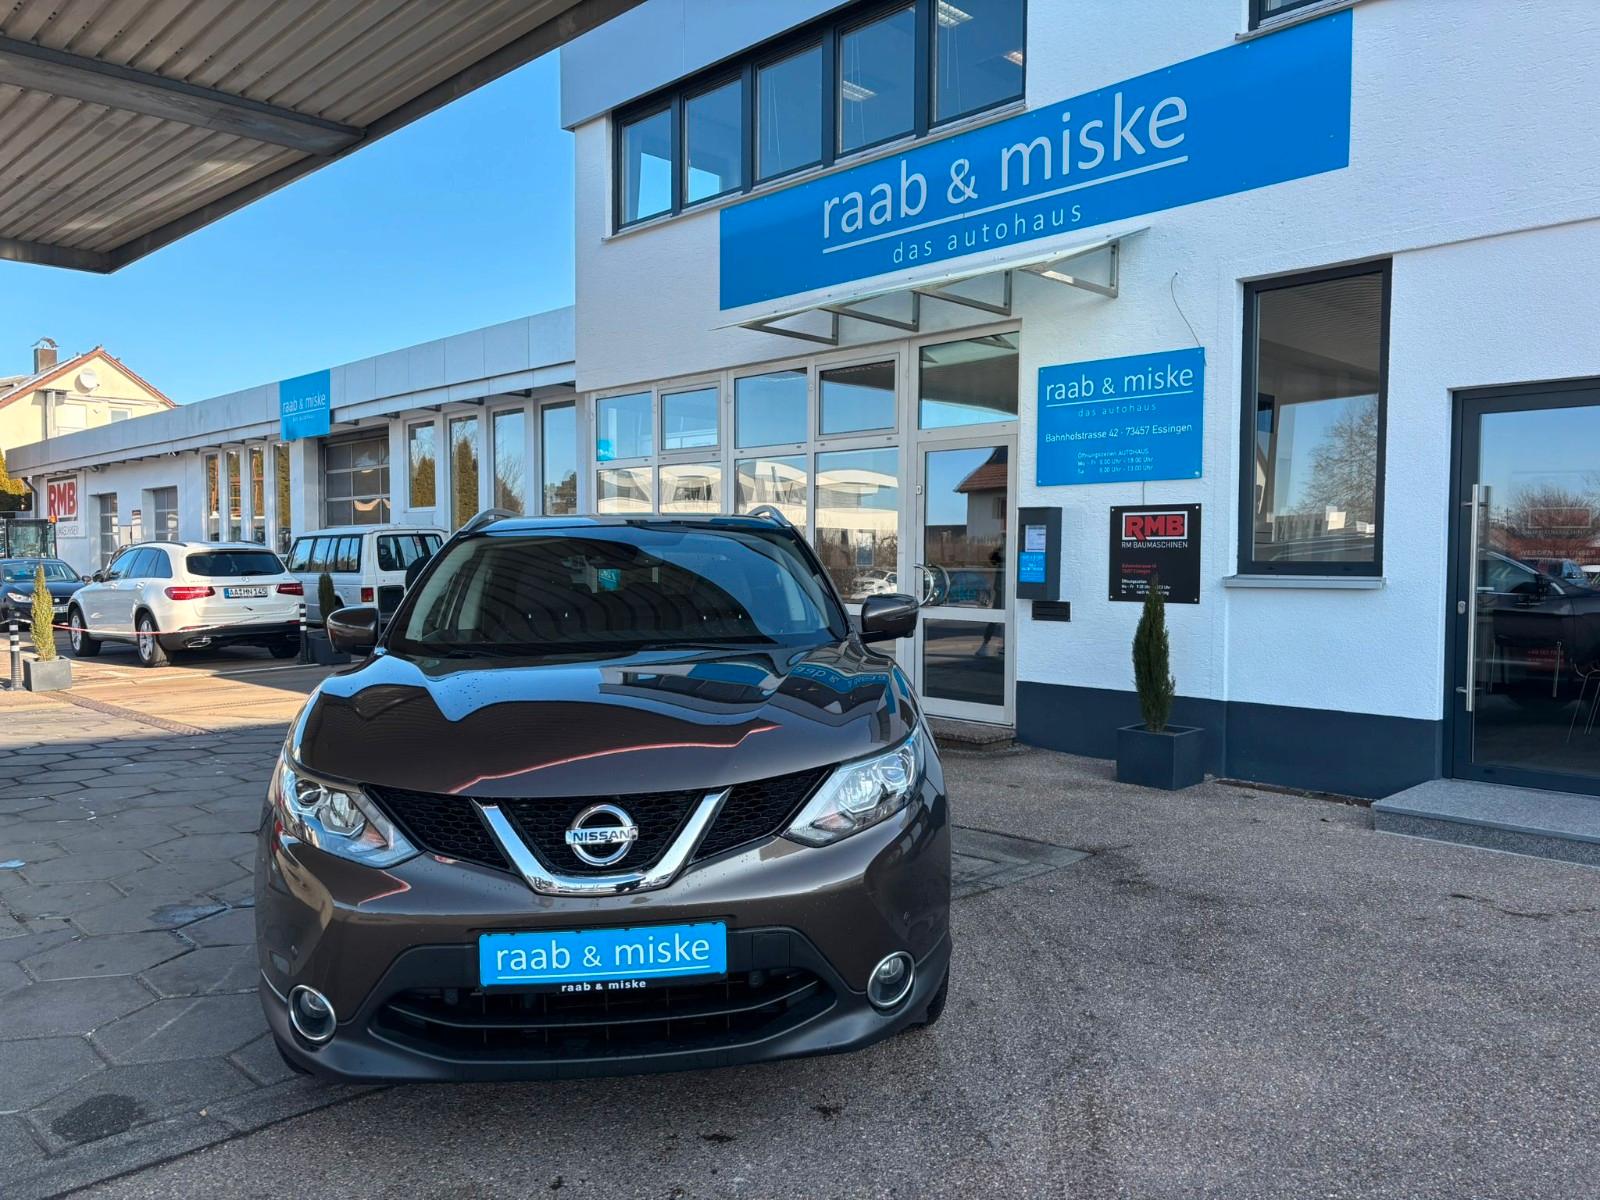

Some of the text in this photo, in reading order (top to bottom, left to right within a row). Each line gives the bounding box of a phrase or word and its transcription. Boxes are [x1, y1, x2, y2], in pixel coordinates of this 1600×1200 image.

[823, 92, 1188, 240] raab & miske
[893, 202, 1082, 264] das autohaus
[1046, 363, 1193, 400] raab & miske
[282, 396, 298, 413] raab
[305, 392, 326, 409] miske
[1078, 403, 1157, 417] das autohaus
[1045, 430, 1107, 443] Bahnhofstrasse
[1109, 428, 1119, 437] 42
[1125, 426, 1150, 436] 73457
[1152, 423, 1193, 435] Essingen
[48, 481, 76, 518] RMB
[1125, 515, 1185, 542] RMB
[1133, 541, 1188, 549] BAUMASCHINEN
[573, 830, 630, 842] NISSAN
[496, 932, 710, 971] raab & miske
[561, 979, 647, 993] raab & miske
